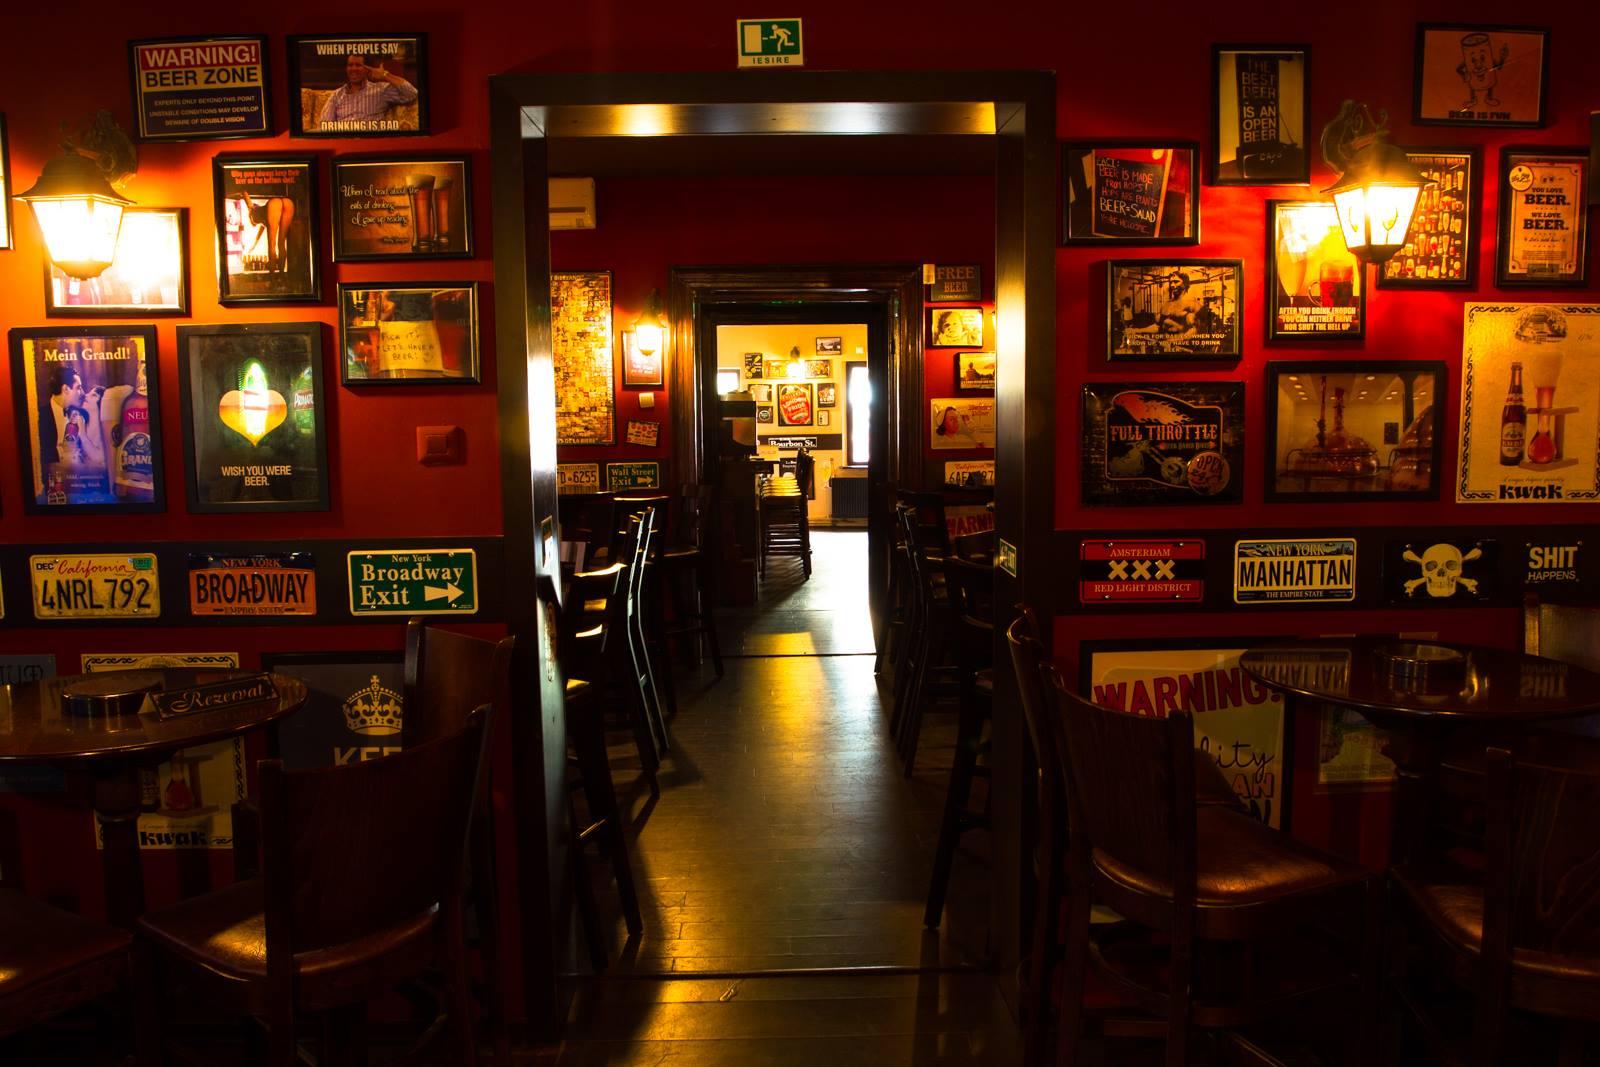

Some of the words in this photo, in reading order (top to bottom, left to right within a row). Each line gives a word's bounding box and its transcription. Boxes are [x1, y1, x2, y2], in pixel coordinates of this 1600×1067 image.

[316, 43, 345, 55] WHEN
[346, 43, 380, 55] PEOPLE
[381, 43, 399, 54] SAY
[145, 45, 257, 68] WARNING!
[145, 70, 198, 87] BEER
[203, 66, 258, 85] ZONE
[1241, 71, 1275, 86] BEST
[1243, 105, 1255, 118] IS
[1259, 105, 1276, 118] AN
[321, 120, 367, 132] DRINKING
[369, 120, 378, 131] IS
[1242, 118, 1277, 131] OPEN
[1243, 130, 1277, 144] BEER
[1131, 170, 1154, 185] MADE
[1524, 194, 1571, 206] BEER.
[1523, 219, 1569, 230] BEER.
[937, 266, 977, 280] FREE
[1298, 323, 1315, 331] SHUT
[1315, 323, 1327, 331] THE
[44, 349, 78, 362] Mein
[81, 347, 131, 361] Grandl!
[1110, 424, 1143, 442] FULL
[1145, 423, 1218, 441] THROTTLE
[770, 440, 803, 448] Bourbon
[804, 439, 817, 448] St.
[221, 465, 245, 477] WISH
[246, 465, 264, 476] YOU
[266, 465, 292, 476] WERE
[631, 468, 655, 476] Street
[244, 476, 270, 486] BEER.
[611, 477, 632, 486] Exit
[1110, 548, 1171, 557] AMSTERDAM
[1268, 545, 1292, 556] NEW
[1294, 545, 1326, 556] YORK
[222, 559, 249, 568] NEW
[251, 559, 282, 568] YORK
[391, 555, 410, 563] New
[412, 554, 432, 562] York
[1528, 546, 1578, 569] SHIT
[36, 562, 54, 571] DEC
[58, 559, 129, 578] California
[361, 562, 464, 585] Broadway
[1239, 559, 1351, 587] MANHATTAN
[1527, 570, 1577, 581] HAPPENS
[196, 573, 308, 604] BROADWAY
[1094, 583, 1115, 592] RED
[1116, 583, 1146, 592] LIGHT
[1147, 582, 1192, 592] DISTRICT
[41, 579, 151, 610] 4NRL792
[360, 584, 410, 605] Exit
